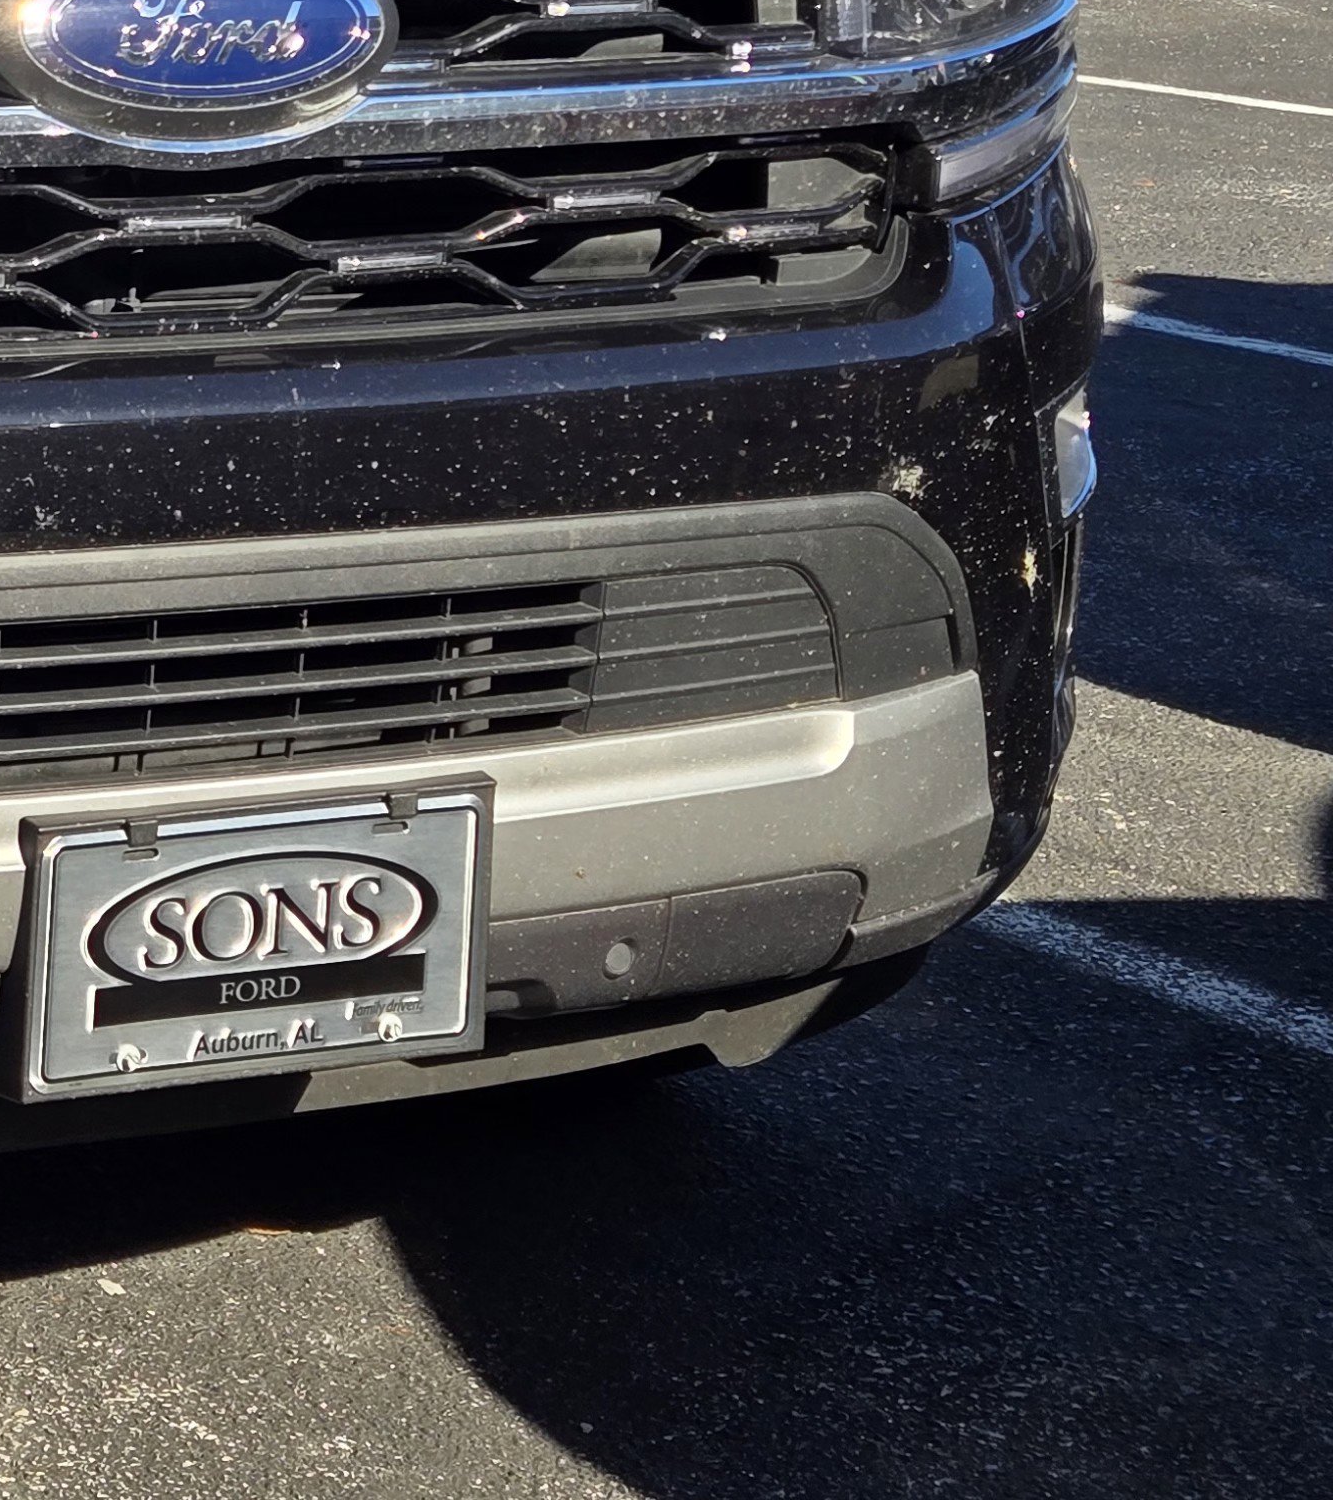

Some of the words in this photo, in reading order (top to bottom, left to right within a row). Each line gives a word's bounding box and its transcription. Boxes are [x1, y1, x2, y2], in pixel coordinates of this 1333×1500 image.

[137, 875, 382, 971] SONS
[219, 976, 301, 1004] FORD
[188, 1027, 287, 1059] Auburn,
[289, 1019, 324, 1048] AL
